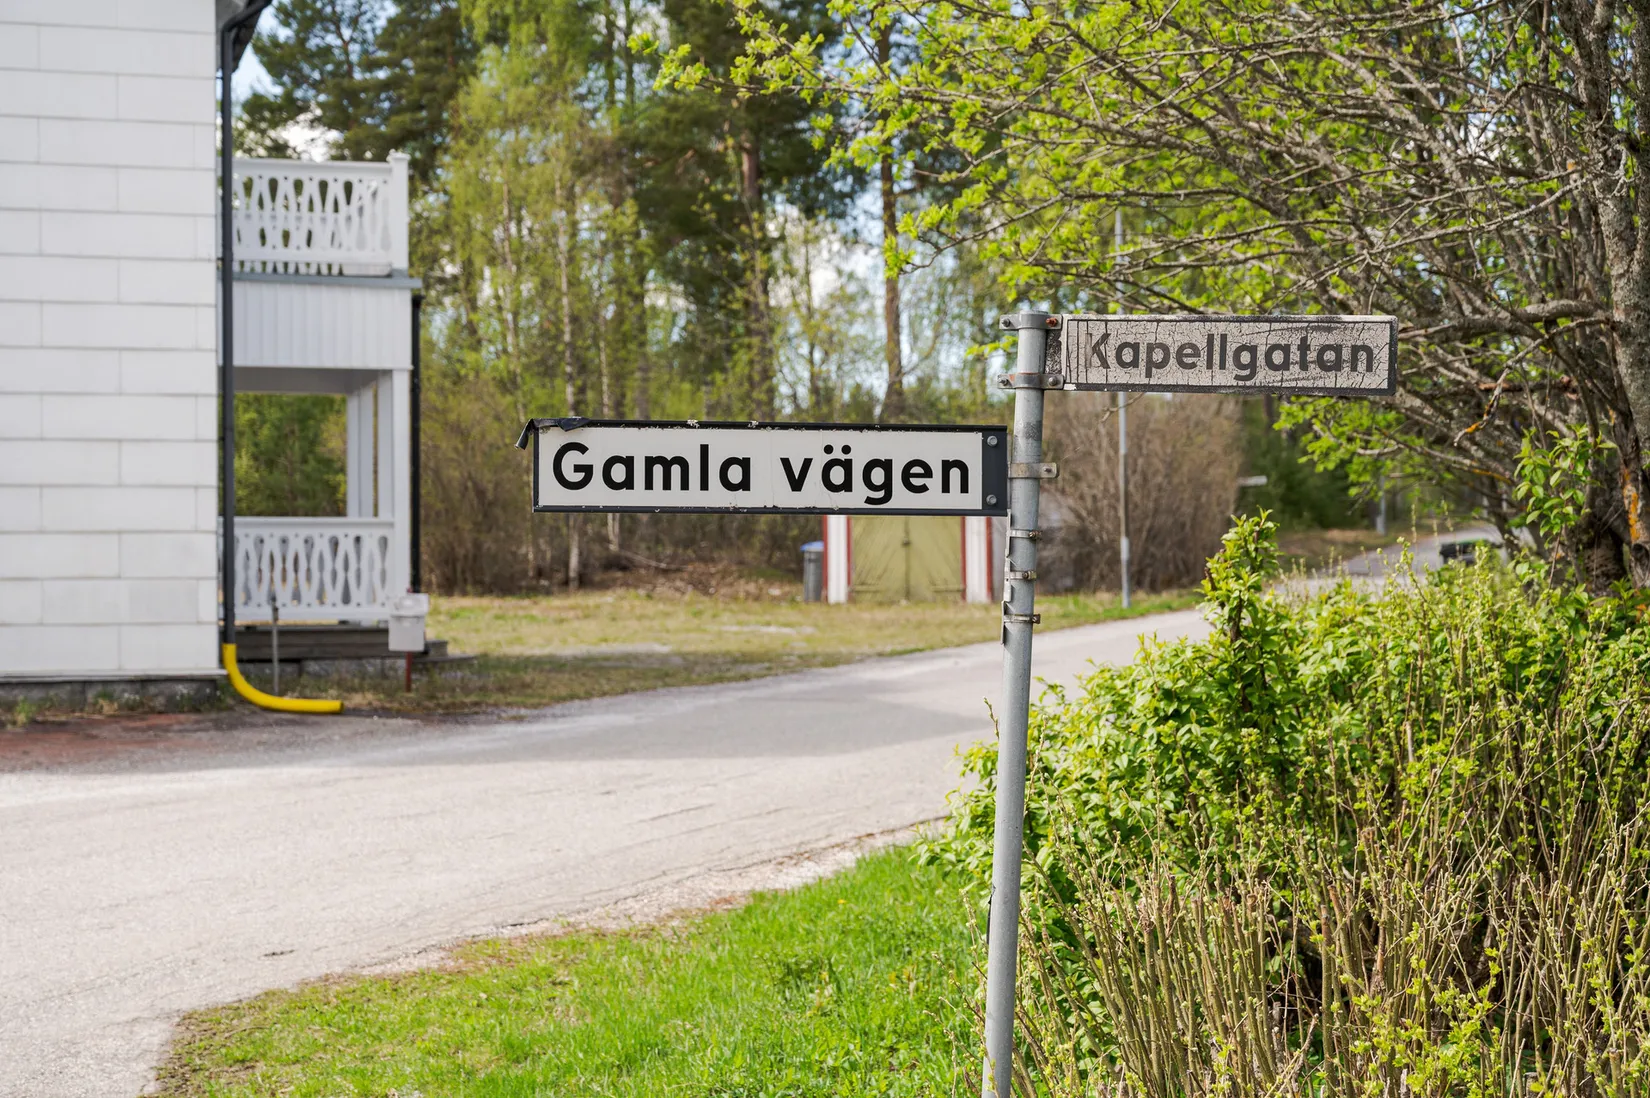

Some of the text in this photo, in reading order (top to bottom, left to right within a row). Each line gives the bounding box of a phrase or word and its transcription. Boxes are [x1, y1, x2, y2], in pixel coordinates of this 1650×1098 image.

[1087, 333, 1375, 382] Kapellgatan
[553, 442, 969, 506] Gamla vägen
